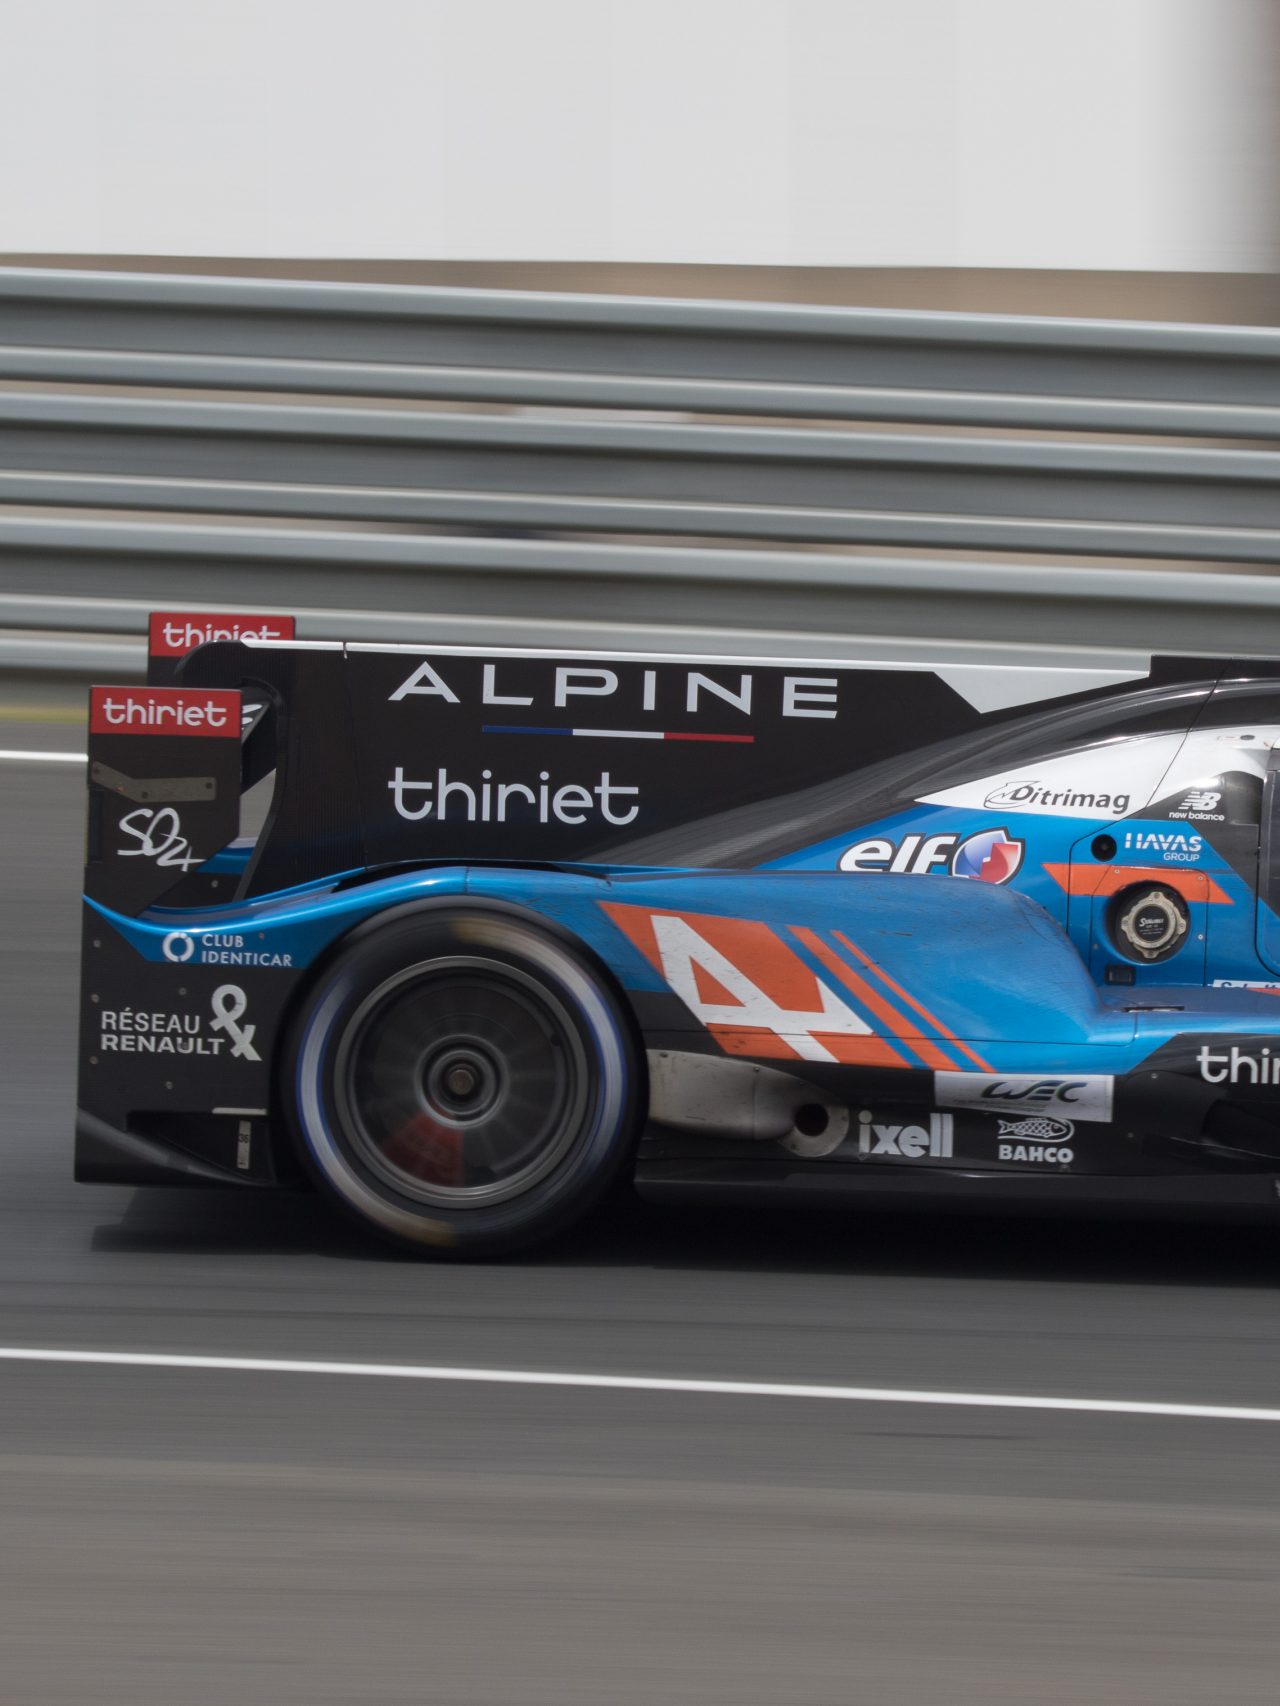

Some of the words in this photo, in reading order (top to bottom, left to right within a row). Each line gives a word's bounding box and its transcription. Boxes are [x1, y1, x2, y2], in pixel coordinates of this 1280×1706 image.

[387, 660, 838, 719] ALPINE
[103, 697, 227, 727] thiriet
[387, 766, 640, 825] thiriet
[1009, 784, 1130, 815] Ditrimag
[1169, 811, 1187, 819] new
[1189, 811, 1225, 822] balance
[838, 832, 959, 873] elf
[1124, 832, 1202, 852] HAVAS
[1163, 852, 1200, 863] GROUP
[202, 933, 244, 949] CLUB
[201, 950, 292, 968] IDENTICAR
[101, 1007, 200, 1034] RÉSEAU
[101, 1034, 225, 1055] RENAULT
[981, 1079, 1088, 1103] WEC
[859, 1109, 954, 1158] ixell
[998, 1144, 1075, 1164] BAHCO
